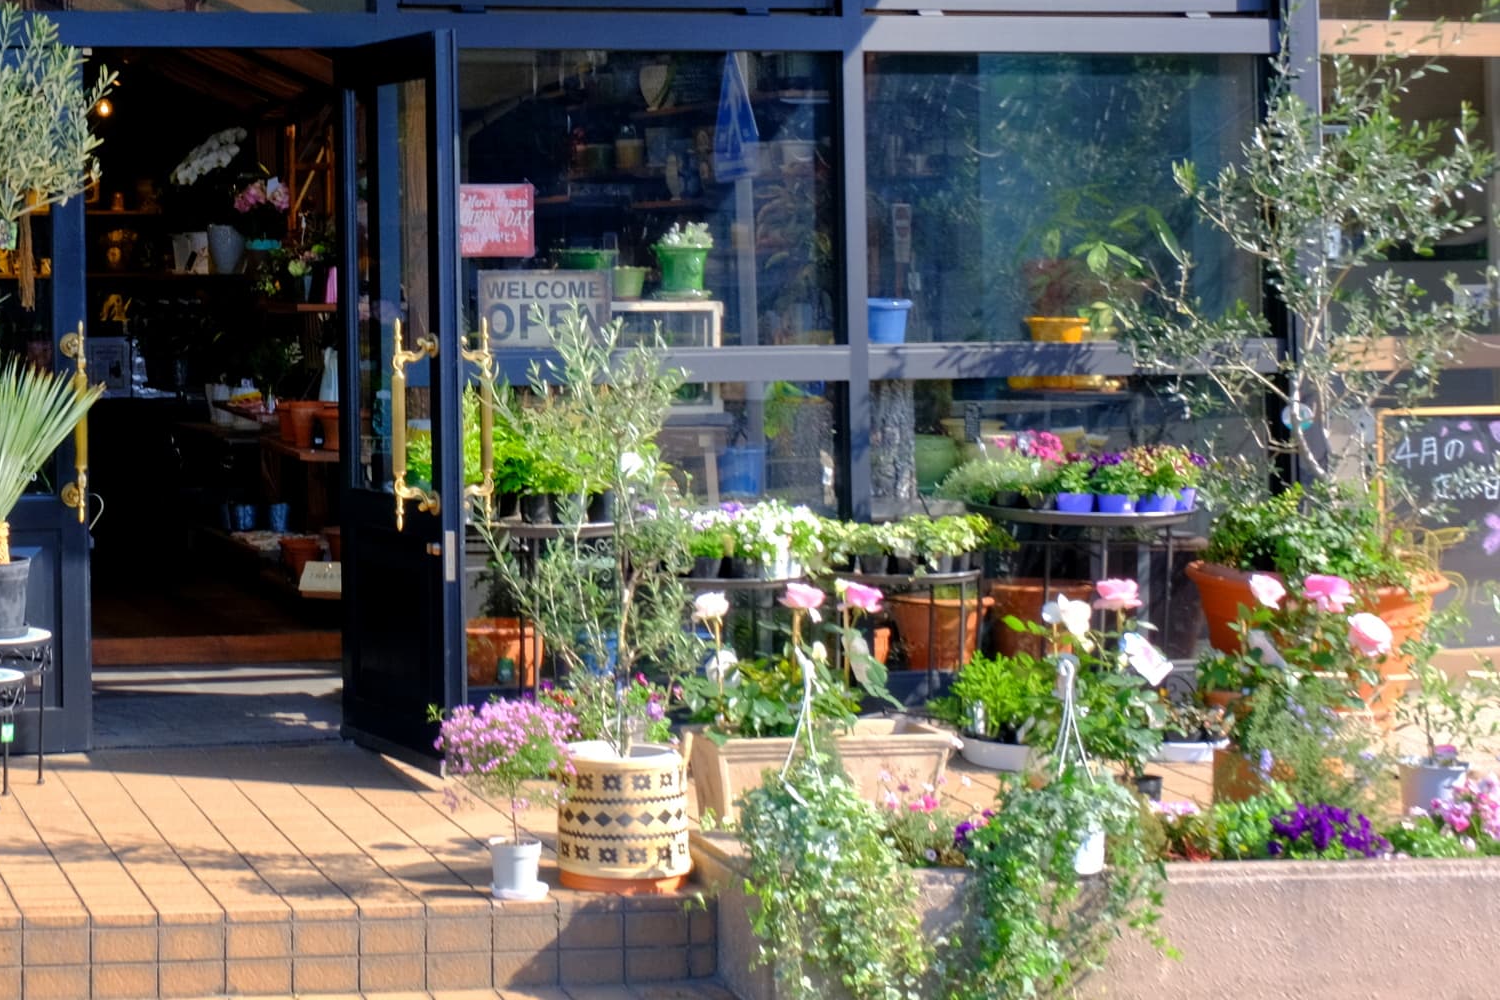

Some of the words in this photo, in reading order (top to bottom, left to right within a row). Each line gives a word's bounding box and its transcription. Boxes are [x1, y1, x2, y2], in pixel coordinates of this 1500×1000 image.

[504, 209, 534, 227] DAY
[487, 280, 601, 300] WELCOME
[1394, 435, 1465, 469] 4月の
